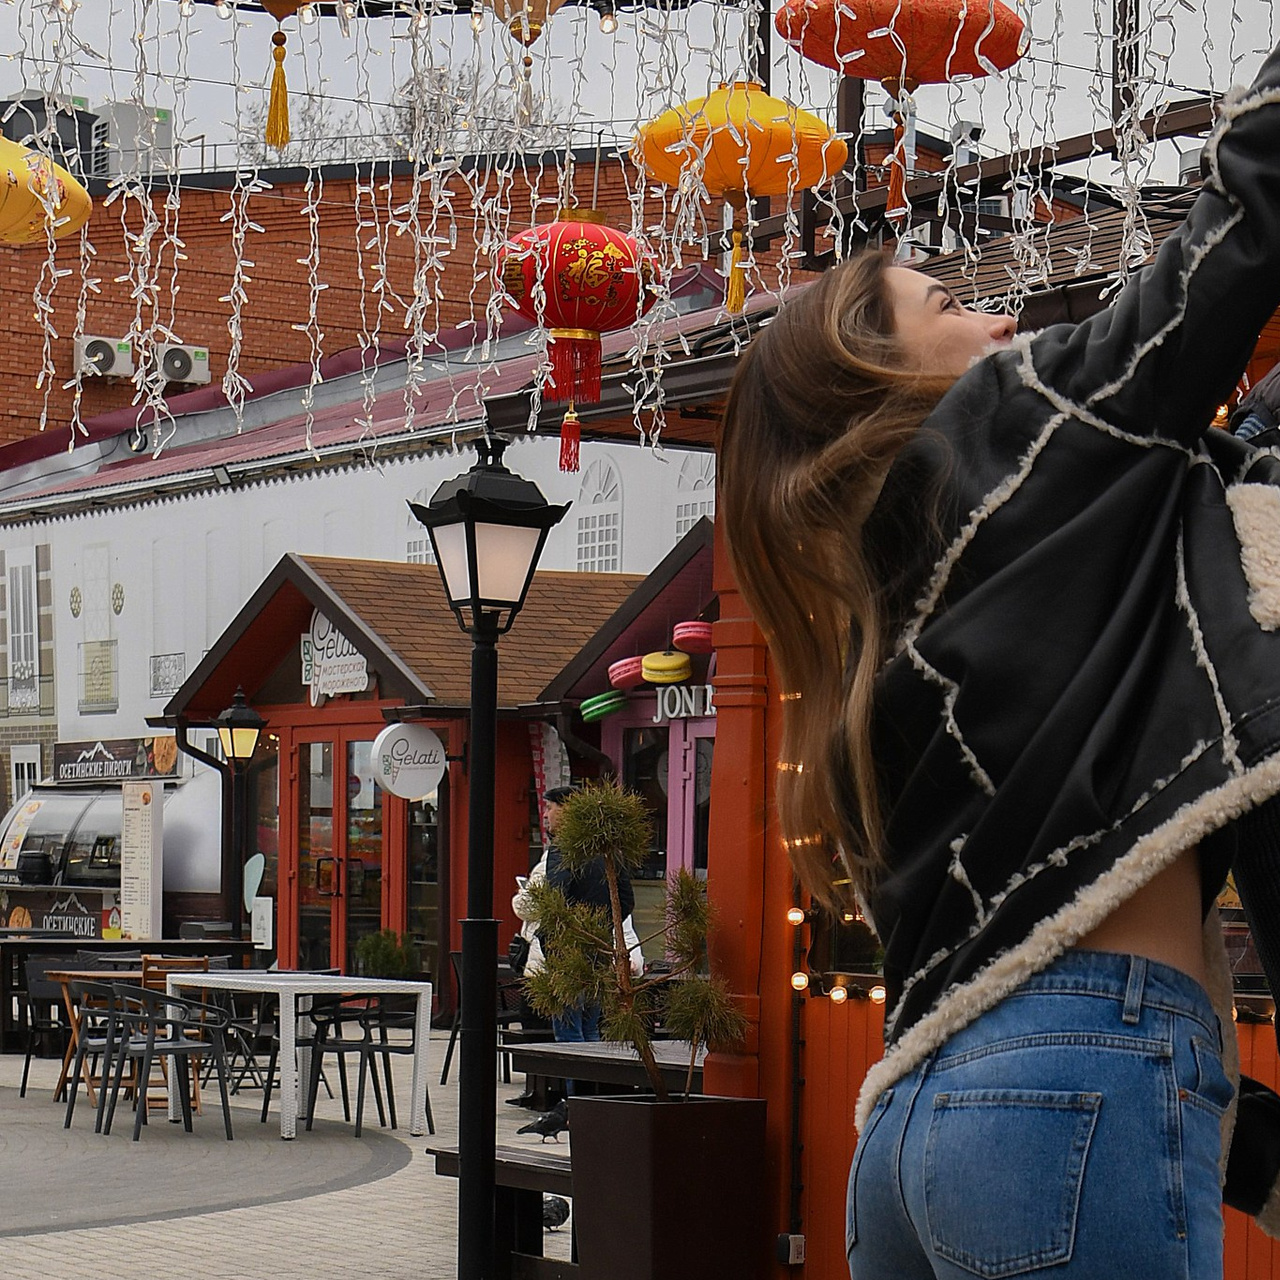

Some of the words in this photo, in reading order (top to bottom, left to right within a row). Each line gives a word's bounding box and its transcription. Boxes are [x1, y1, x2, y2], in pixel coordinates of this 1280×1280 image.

[653, 685, 697, 723] JON
[391, 738, 441, 766] Gelati
[60, 761, 103, 779] ОСЕТИНСКИЕ
[104, 760, 132, 776] ПИРОГИ
[43, 915, 96, 937] ОСЕТИНСКИЕ
